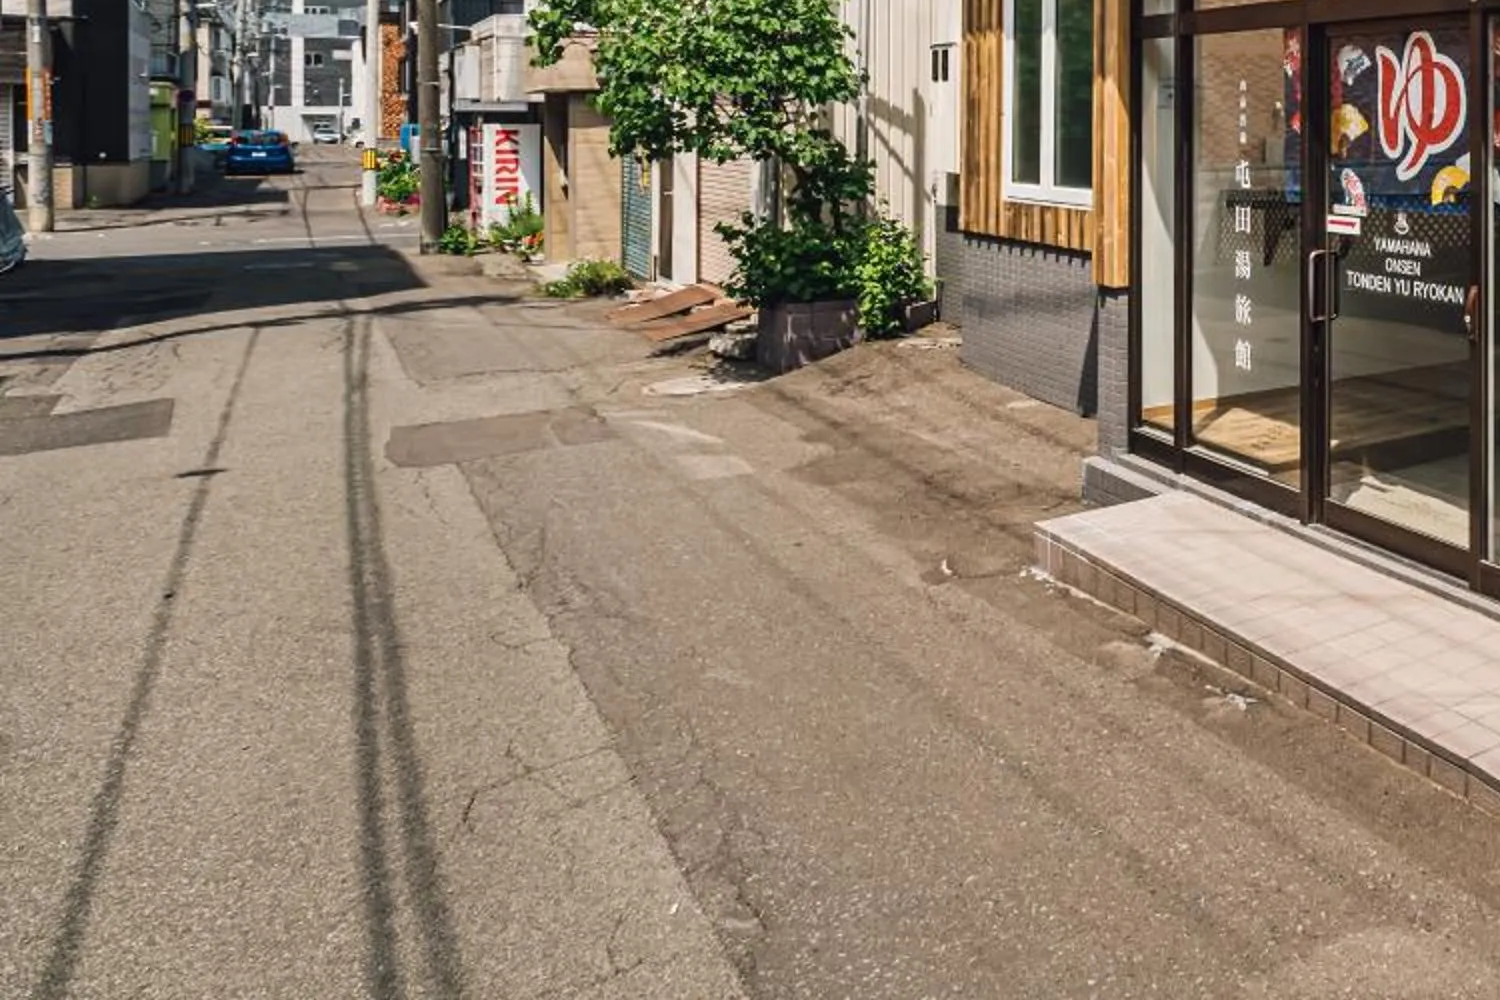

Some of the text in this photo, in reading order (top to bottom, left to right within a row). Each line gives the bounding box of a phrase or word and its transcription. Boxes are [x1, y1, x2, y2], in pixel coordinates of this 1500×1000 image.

[1375, 30, 1467, 182] ゆ
[496, 129, 519, 205] KIRIN
[1374, 236, 1432, 258] YAMAHANA
[1385, 257, 1421, 277] ONSEN
[1346, 269, 1465, 305] TONDEN YU RYOKAN
